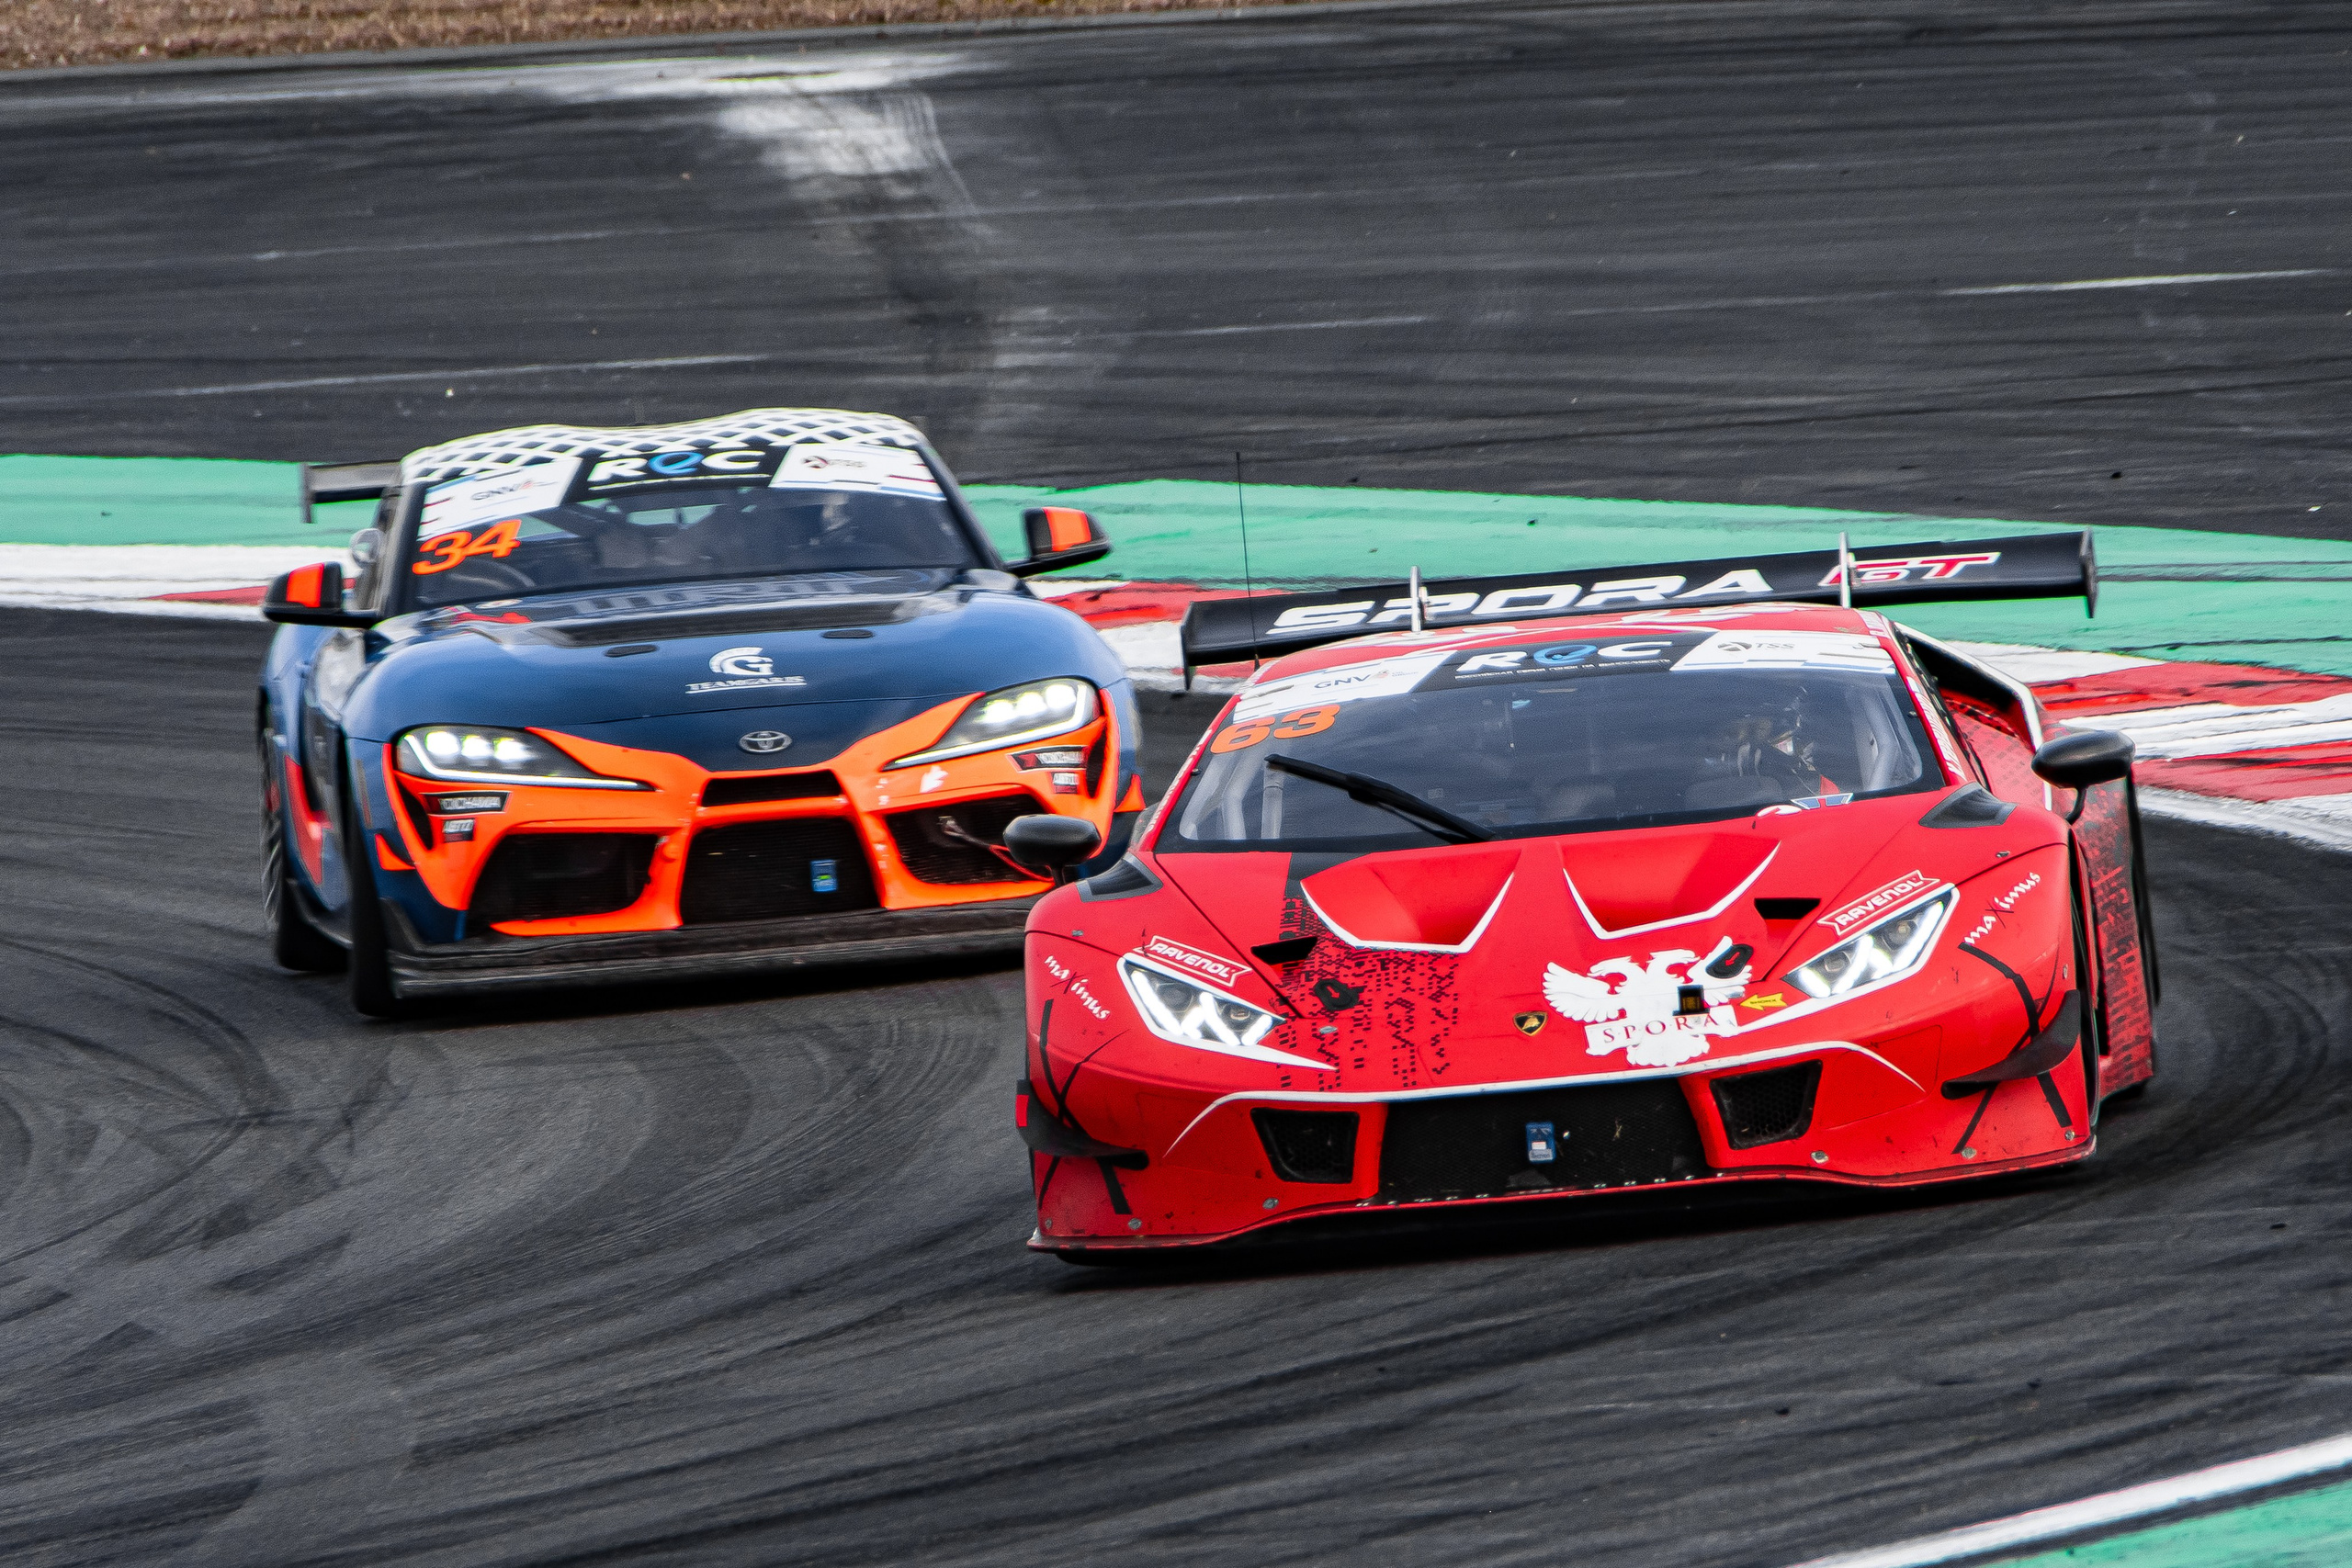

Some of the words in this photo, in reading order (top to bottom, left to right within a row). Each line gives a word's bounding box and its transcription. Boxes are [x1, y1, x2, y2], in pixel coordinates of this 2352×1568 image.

[412, 518, 522, 575] 34
[1818, 552, 2001, 587] GT
[1265, 569, 1773, 636] SPORA
[1314, 674, 1371, 689] GNV
[1210, 704, 1340, 754] 63
[1834, 878, 1924, 926] RAVENOL
[1150, 942, 1231, 978] RAVENOL
